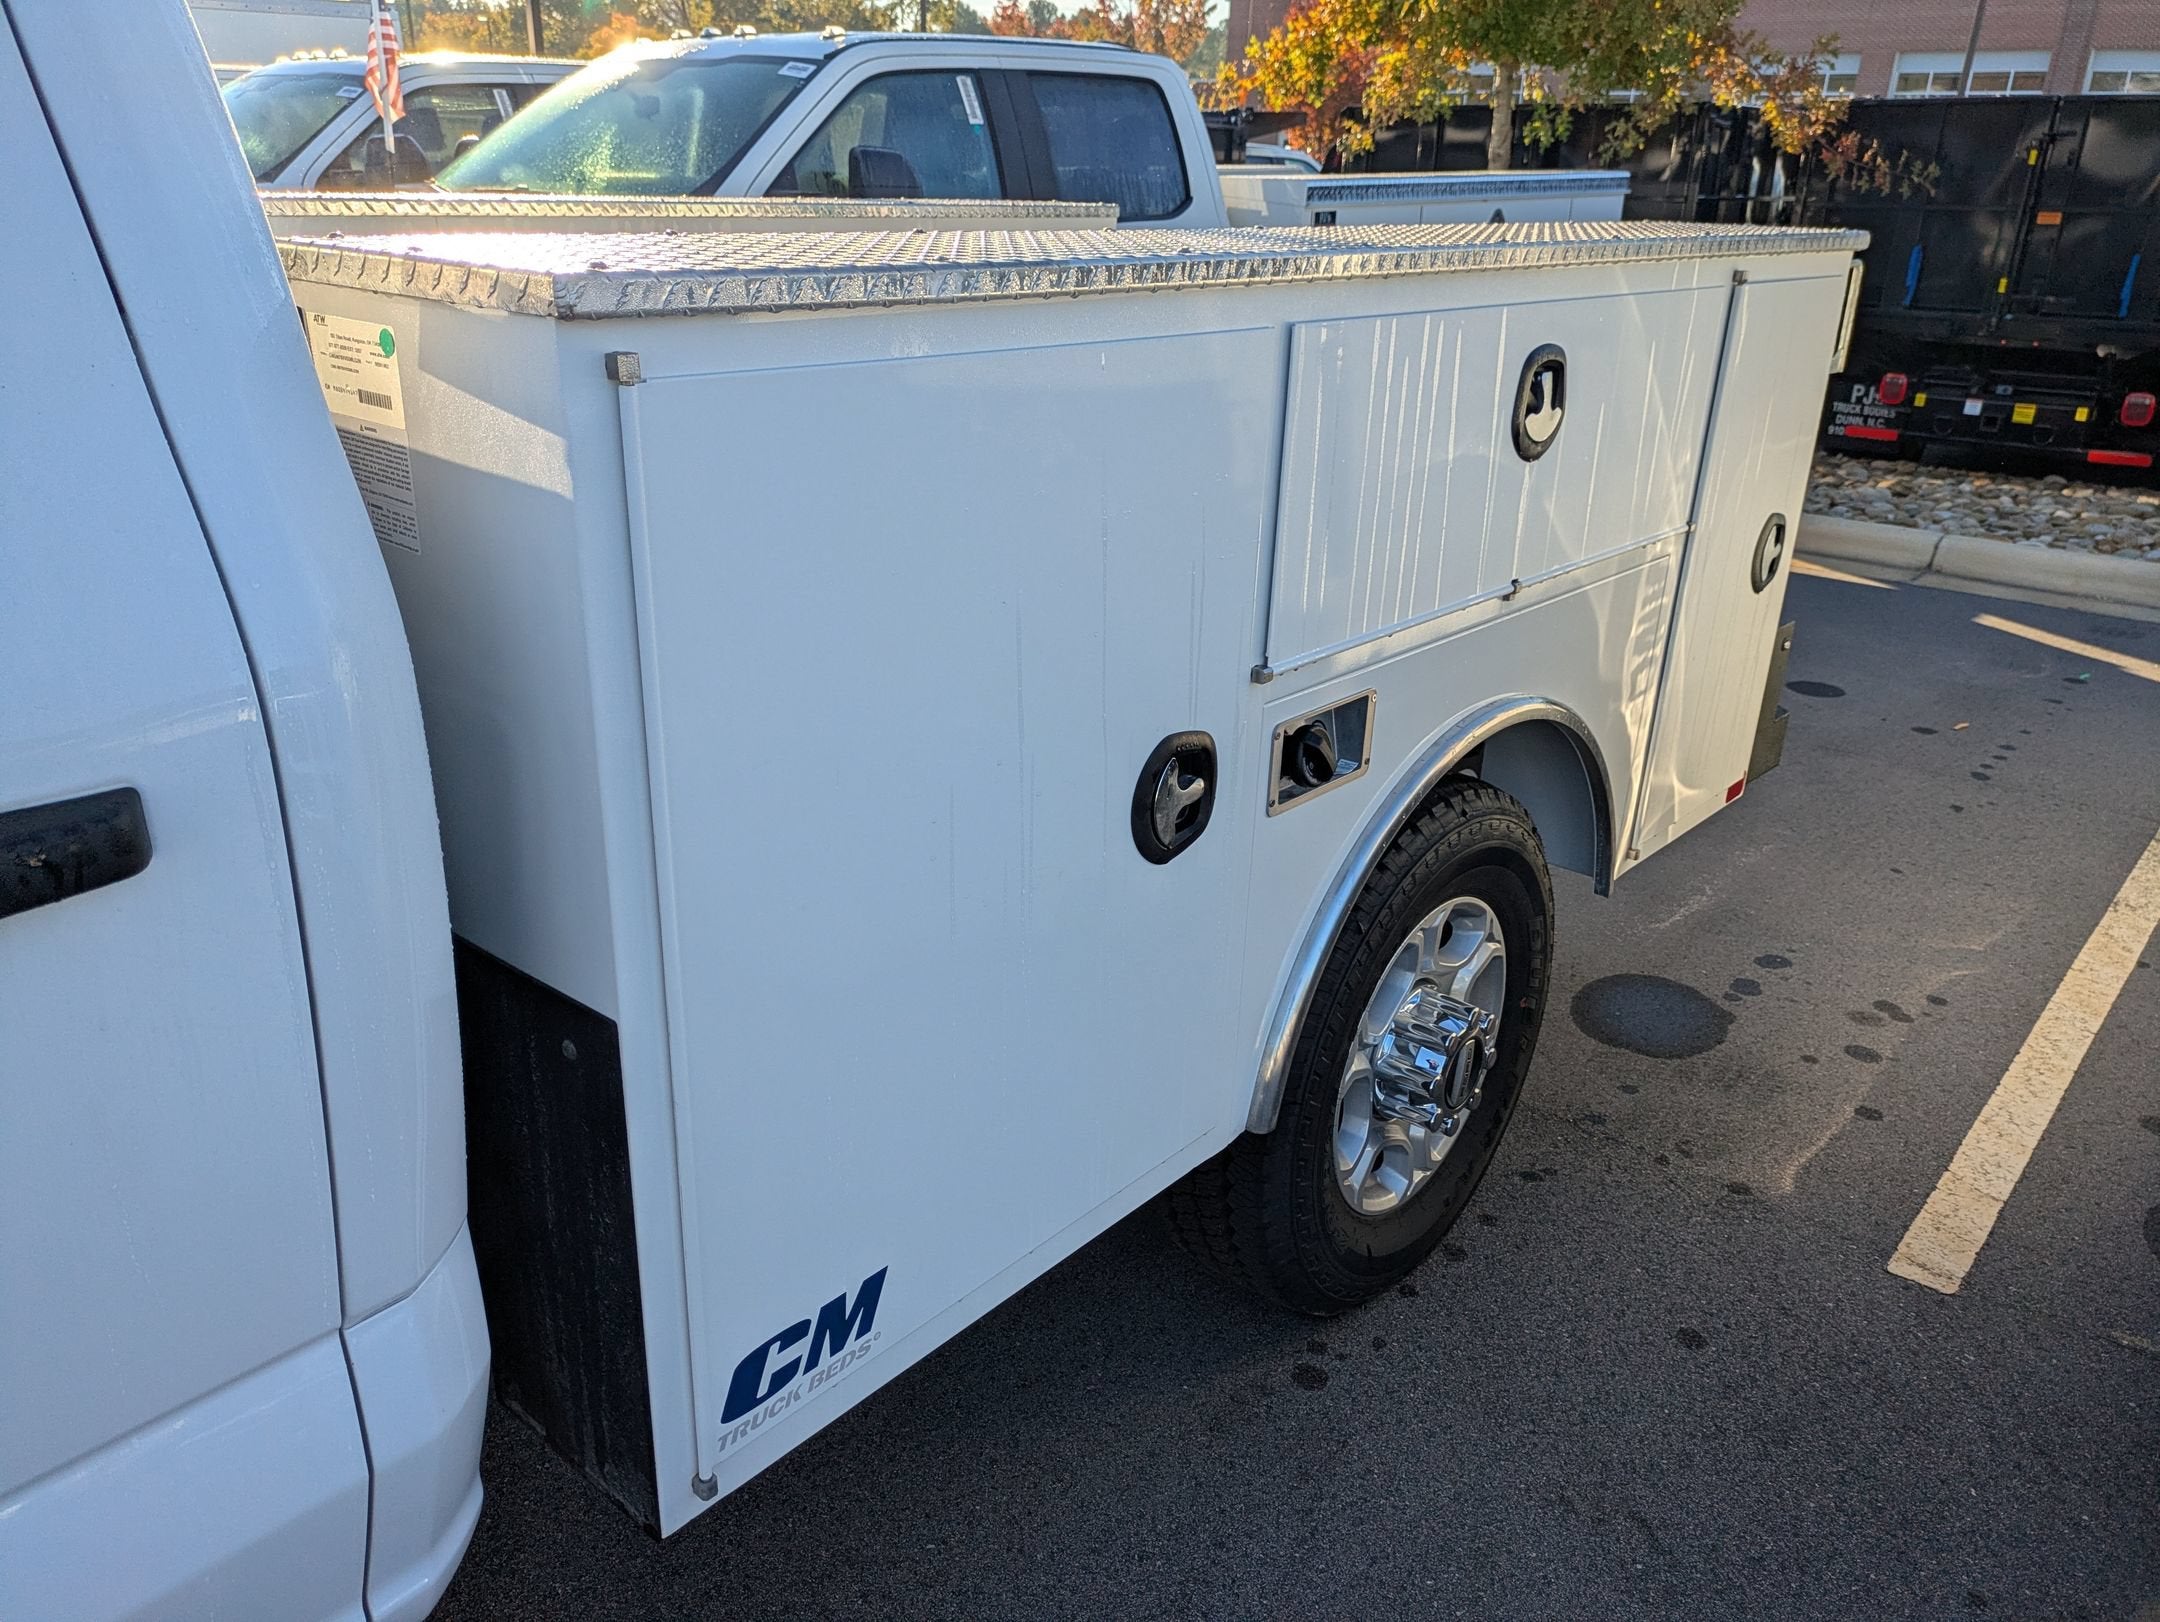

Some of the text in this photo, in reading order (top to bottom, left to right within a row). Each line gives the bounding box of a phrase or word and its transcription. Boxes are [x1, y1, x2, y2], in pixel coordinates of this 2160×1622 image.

[313, 314, 326, 324] ATW
[1832, 401, 1862, 414] TRUCK
[720, 1265, 889, 1425] CM
[717, 1383, 803, 1453] TRUCK
